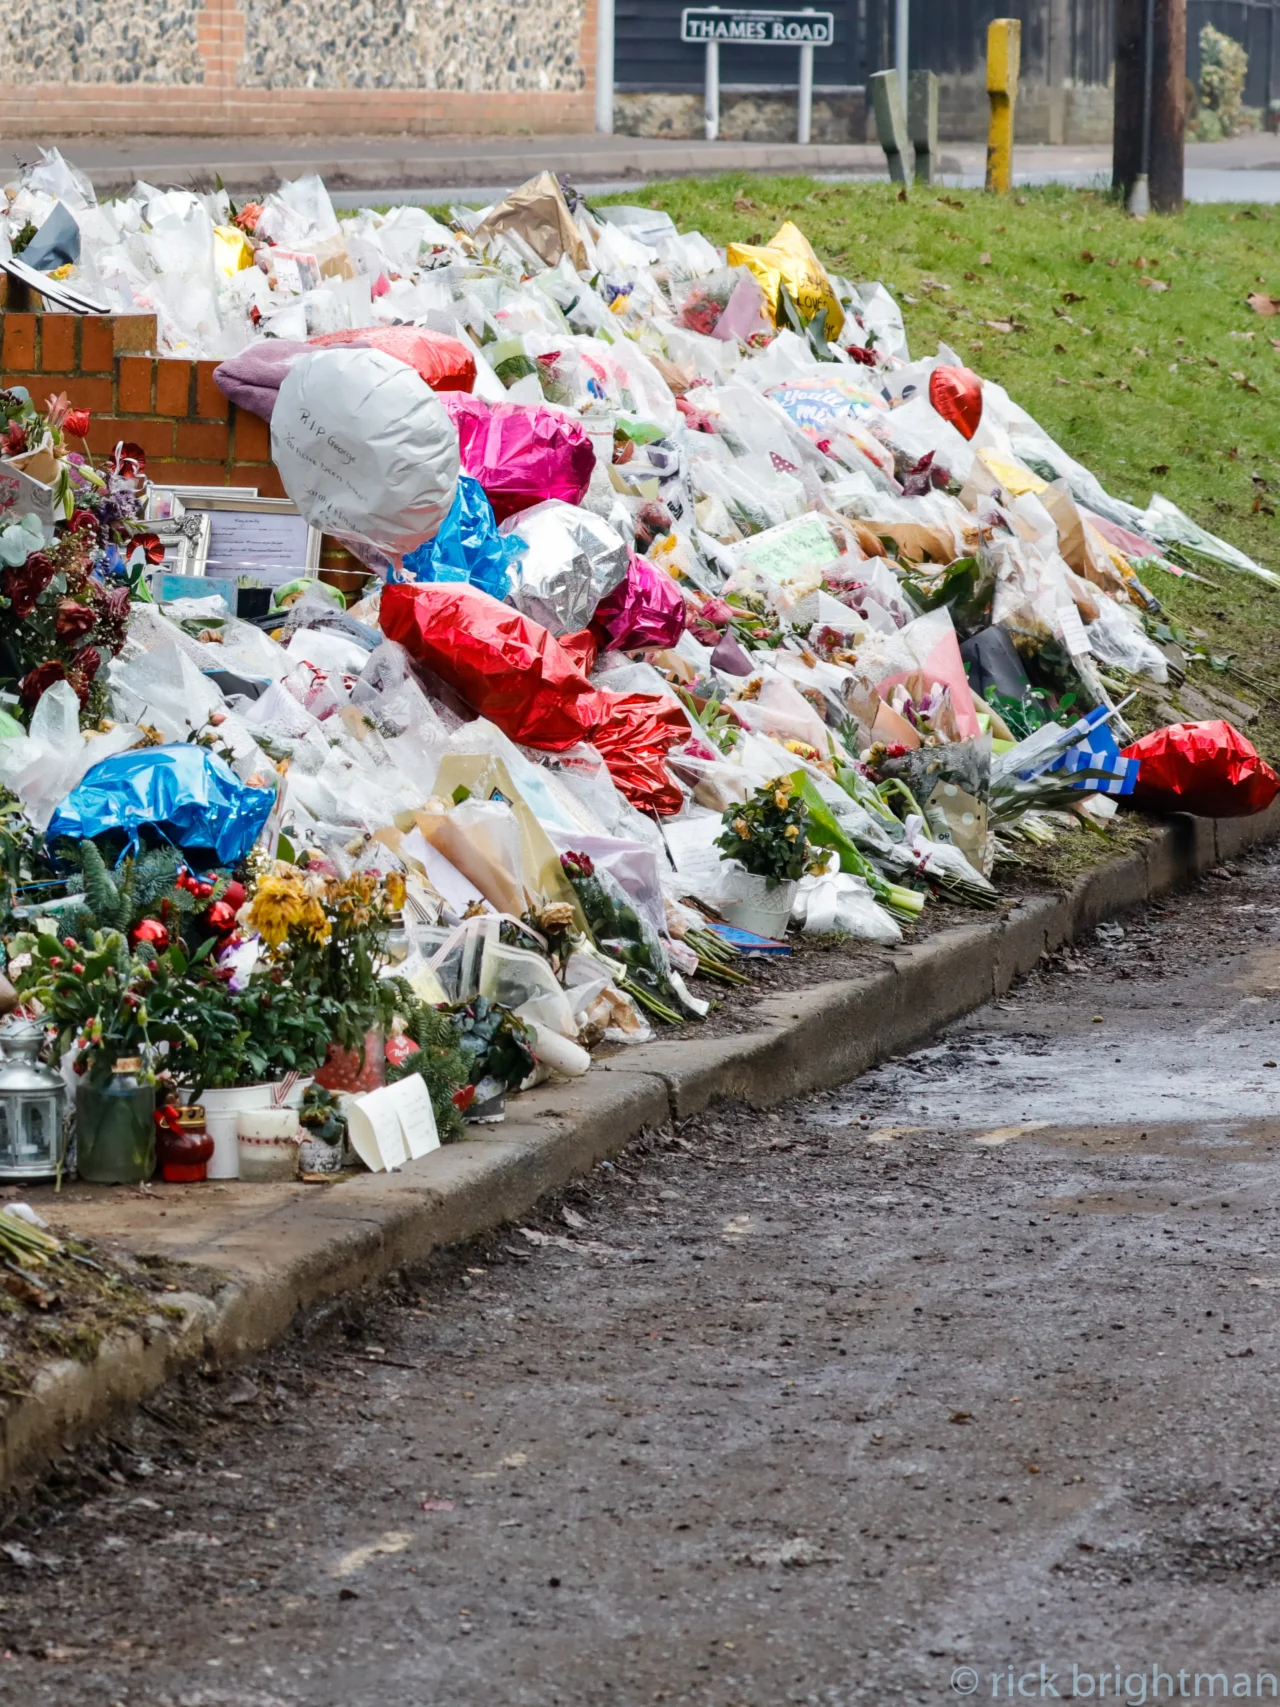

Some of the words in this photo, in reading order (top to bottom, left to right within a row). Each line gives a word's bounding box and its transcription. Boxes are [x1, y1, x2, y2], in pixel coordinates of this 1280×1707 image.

[688, 20, 766, 39] THAMES
[772, 22, 828, 40] ROAD
[295, 446, 318, 467] have
[320, 461, 343, 482] been
[326, 435, 357, 465] George
